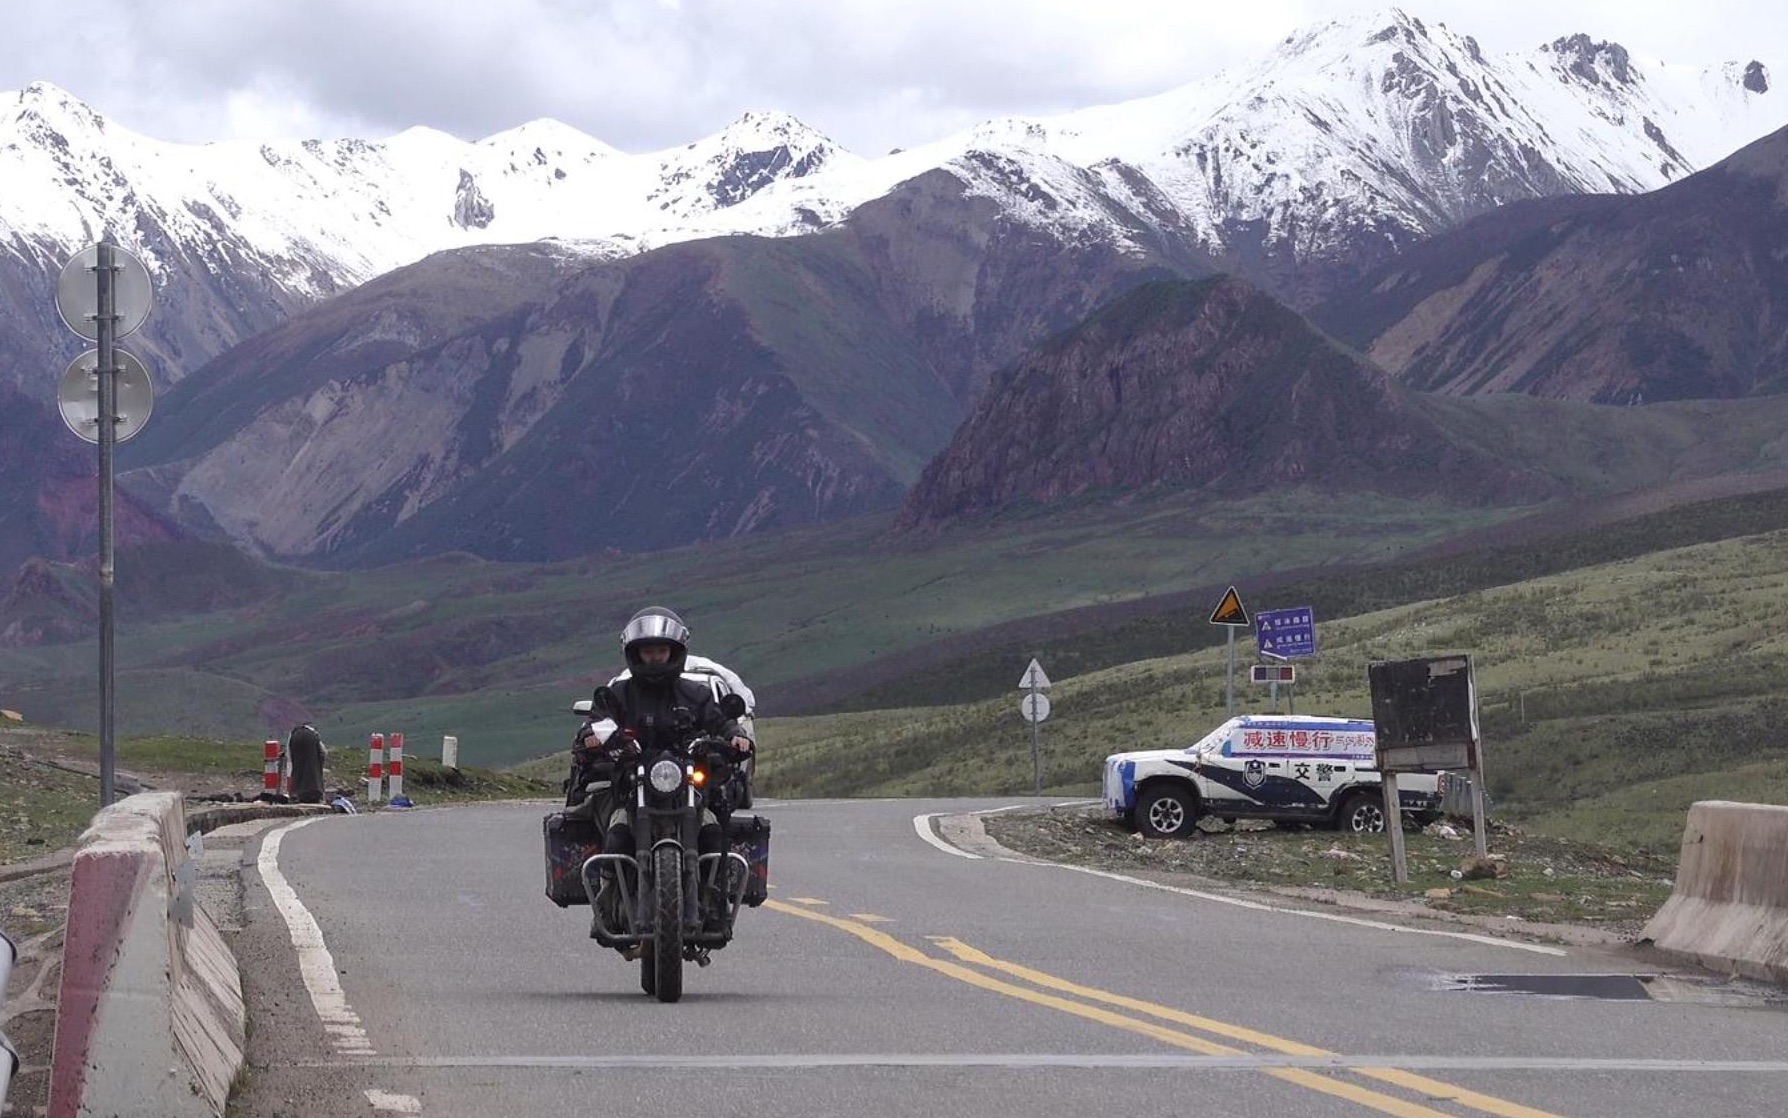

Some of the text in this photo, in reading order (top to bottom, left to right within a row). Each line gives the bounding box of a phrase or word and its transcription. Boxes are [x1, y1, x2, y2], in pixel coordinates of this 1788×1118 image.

[1244, 731, 1332, 749] 减速慢行
[1294, 763, 1333, 781] 交警
